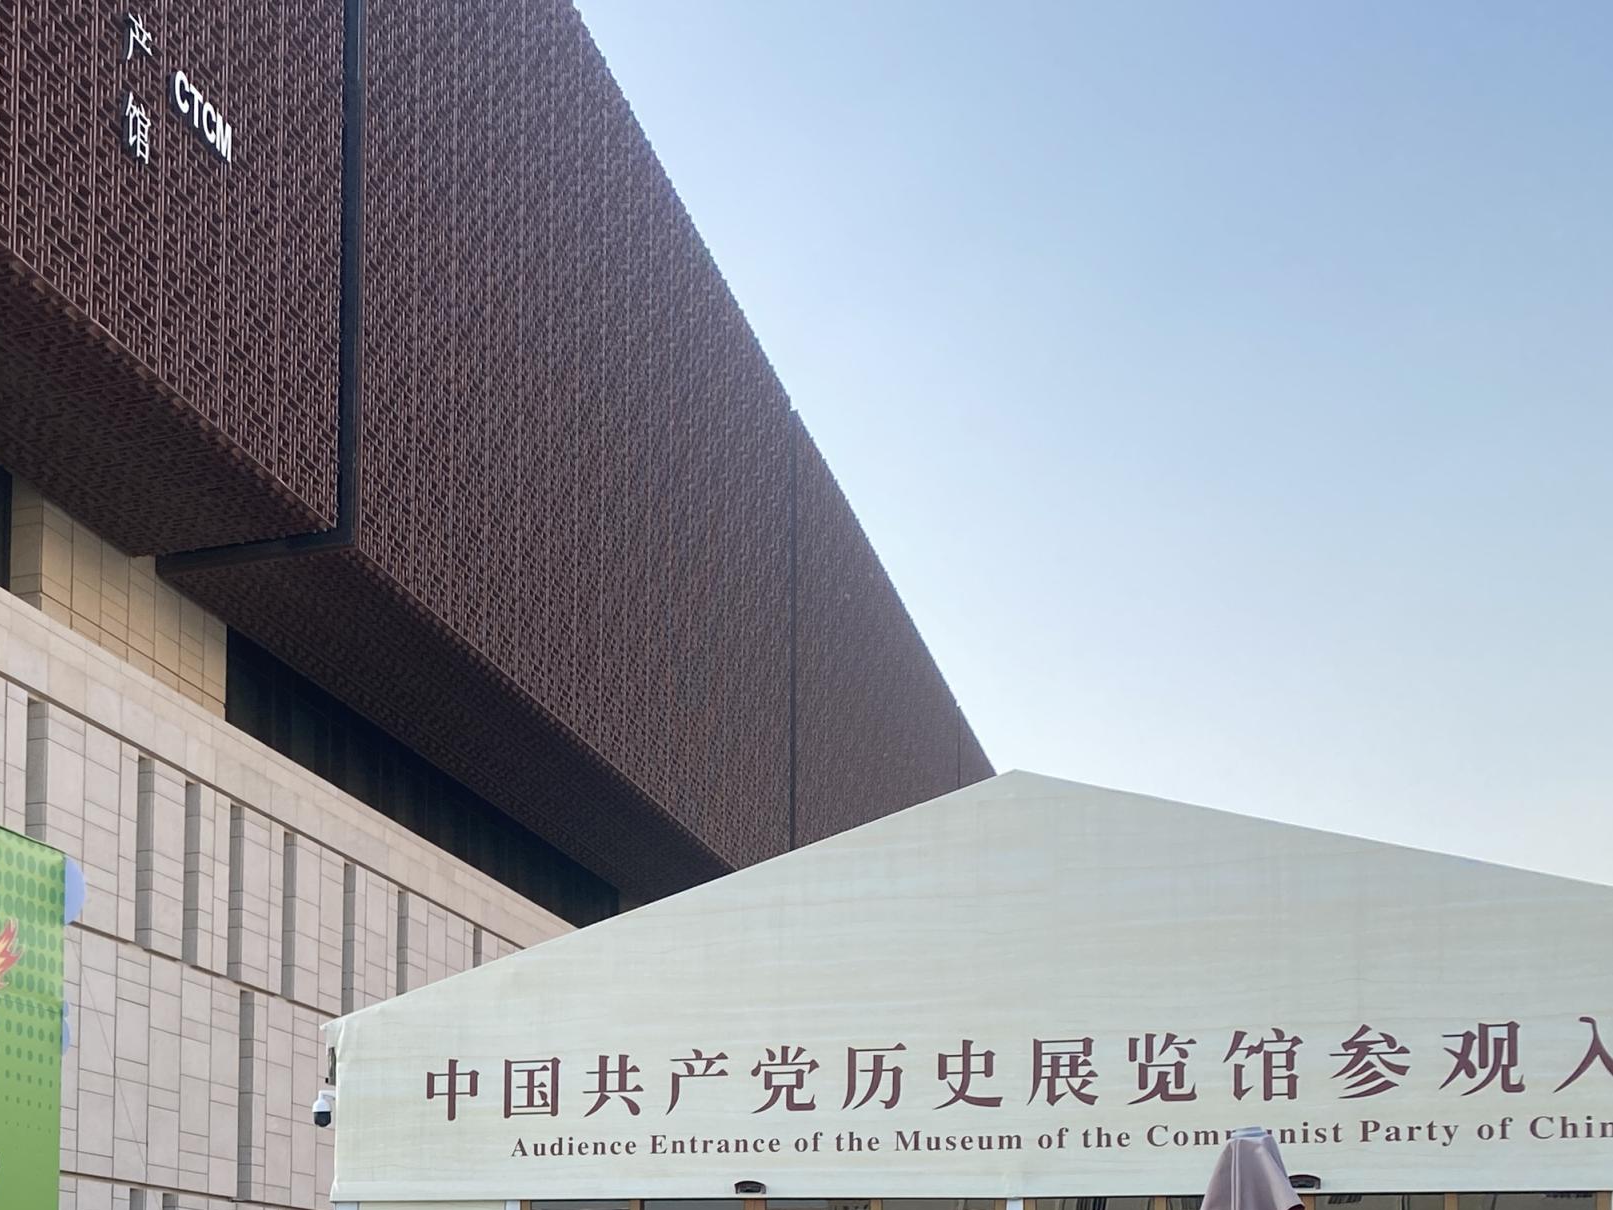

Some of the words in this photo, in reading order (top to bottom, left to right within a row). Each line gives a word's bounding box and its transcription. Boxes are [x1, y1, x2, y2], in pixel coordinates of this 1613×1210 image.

[173, 70, 232, 162] CTCM
[426, 1016, 1613, 1122] 中国共产党历史展览馆参观入
[511, 1137, 638, 1158] Audience
[650, 1135, 781, 1155] Entrance
[794, 1131, 823, 1152] of
[835, 1131, 881, 1152] the
[894, 1129, 1023, 1151] Museum
[1038, 1127, 1069, 1149] of
[1082, 1125, 1132, 1148] the
[1146, 1121, 1343, 1147] Comnist
[1359, 1120, 1459, 1147] Party
[1477, 1116, 1514, 1141] of
